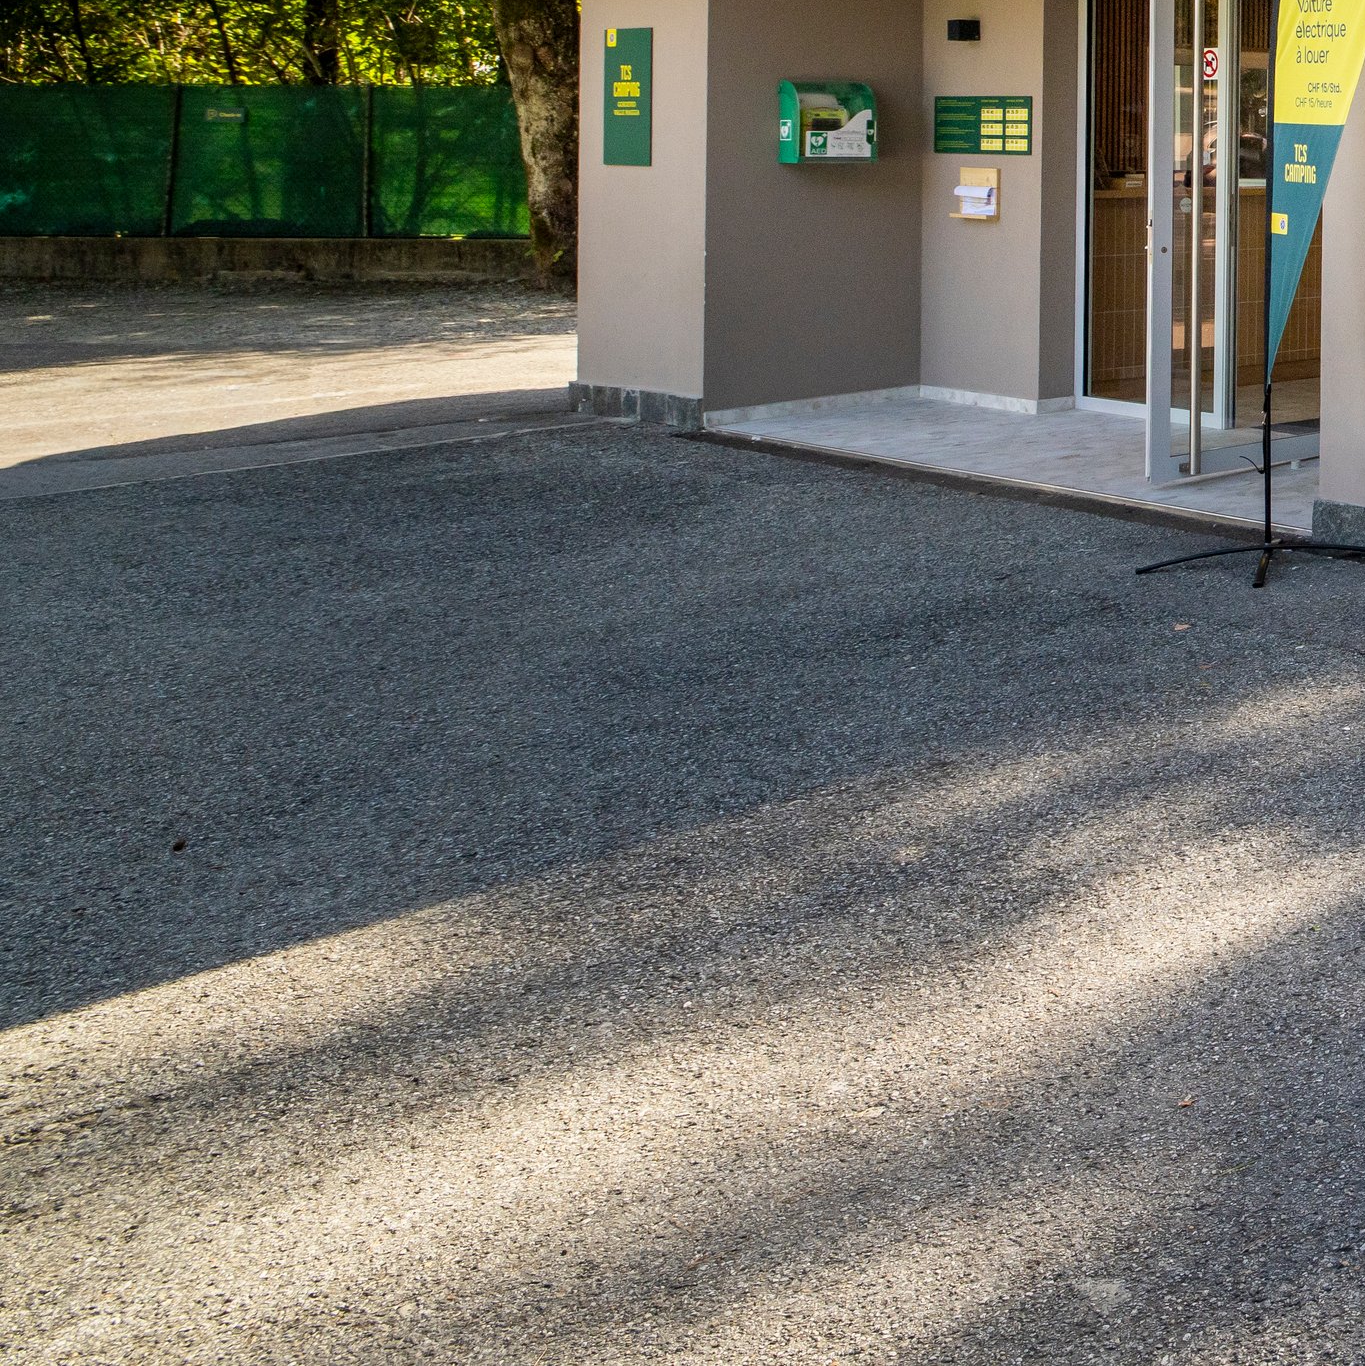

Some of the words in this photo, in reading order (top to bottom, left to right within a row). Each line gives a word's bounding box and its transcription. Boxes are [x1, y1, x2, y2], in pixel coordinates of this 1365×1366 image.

[1295, 19, 1347, 42] électrique
[1296, 45, 1302, 64] à
[1304, 45, 1330, 64] louer
[1307, 82, 1320, 93] CHF
[1295, 97, 1308, 108] CHF
[1294, 143, 1308, 163] TCS
[1284, 163, 1316, 184] CAMPING
